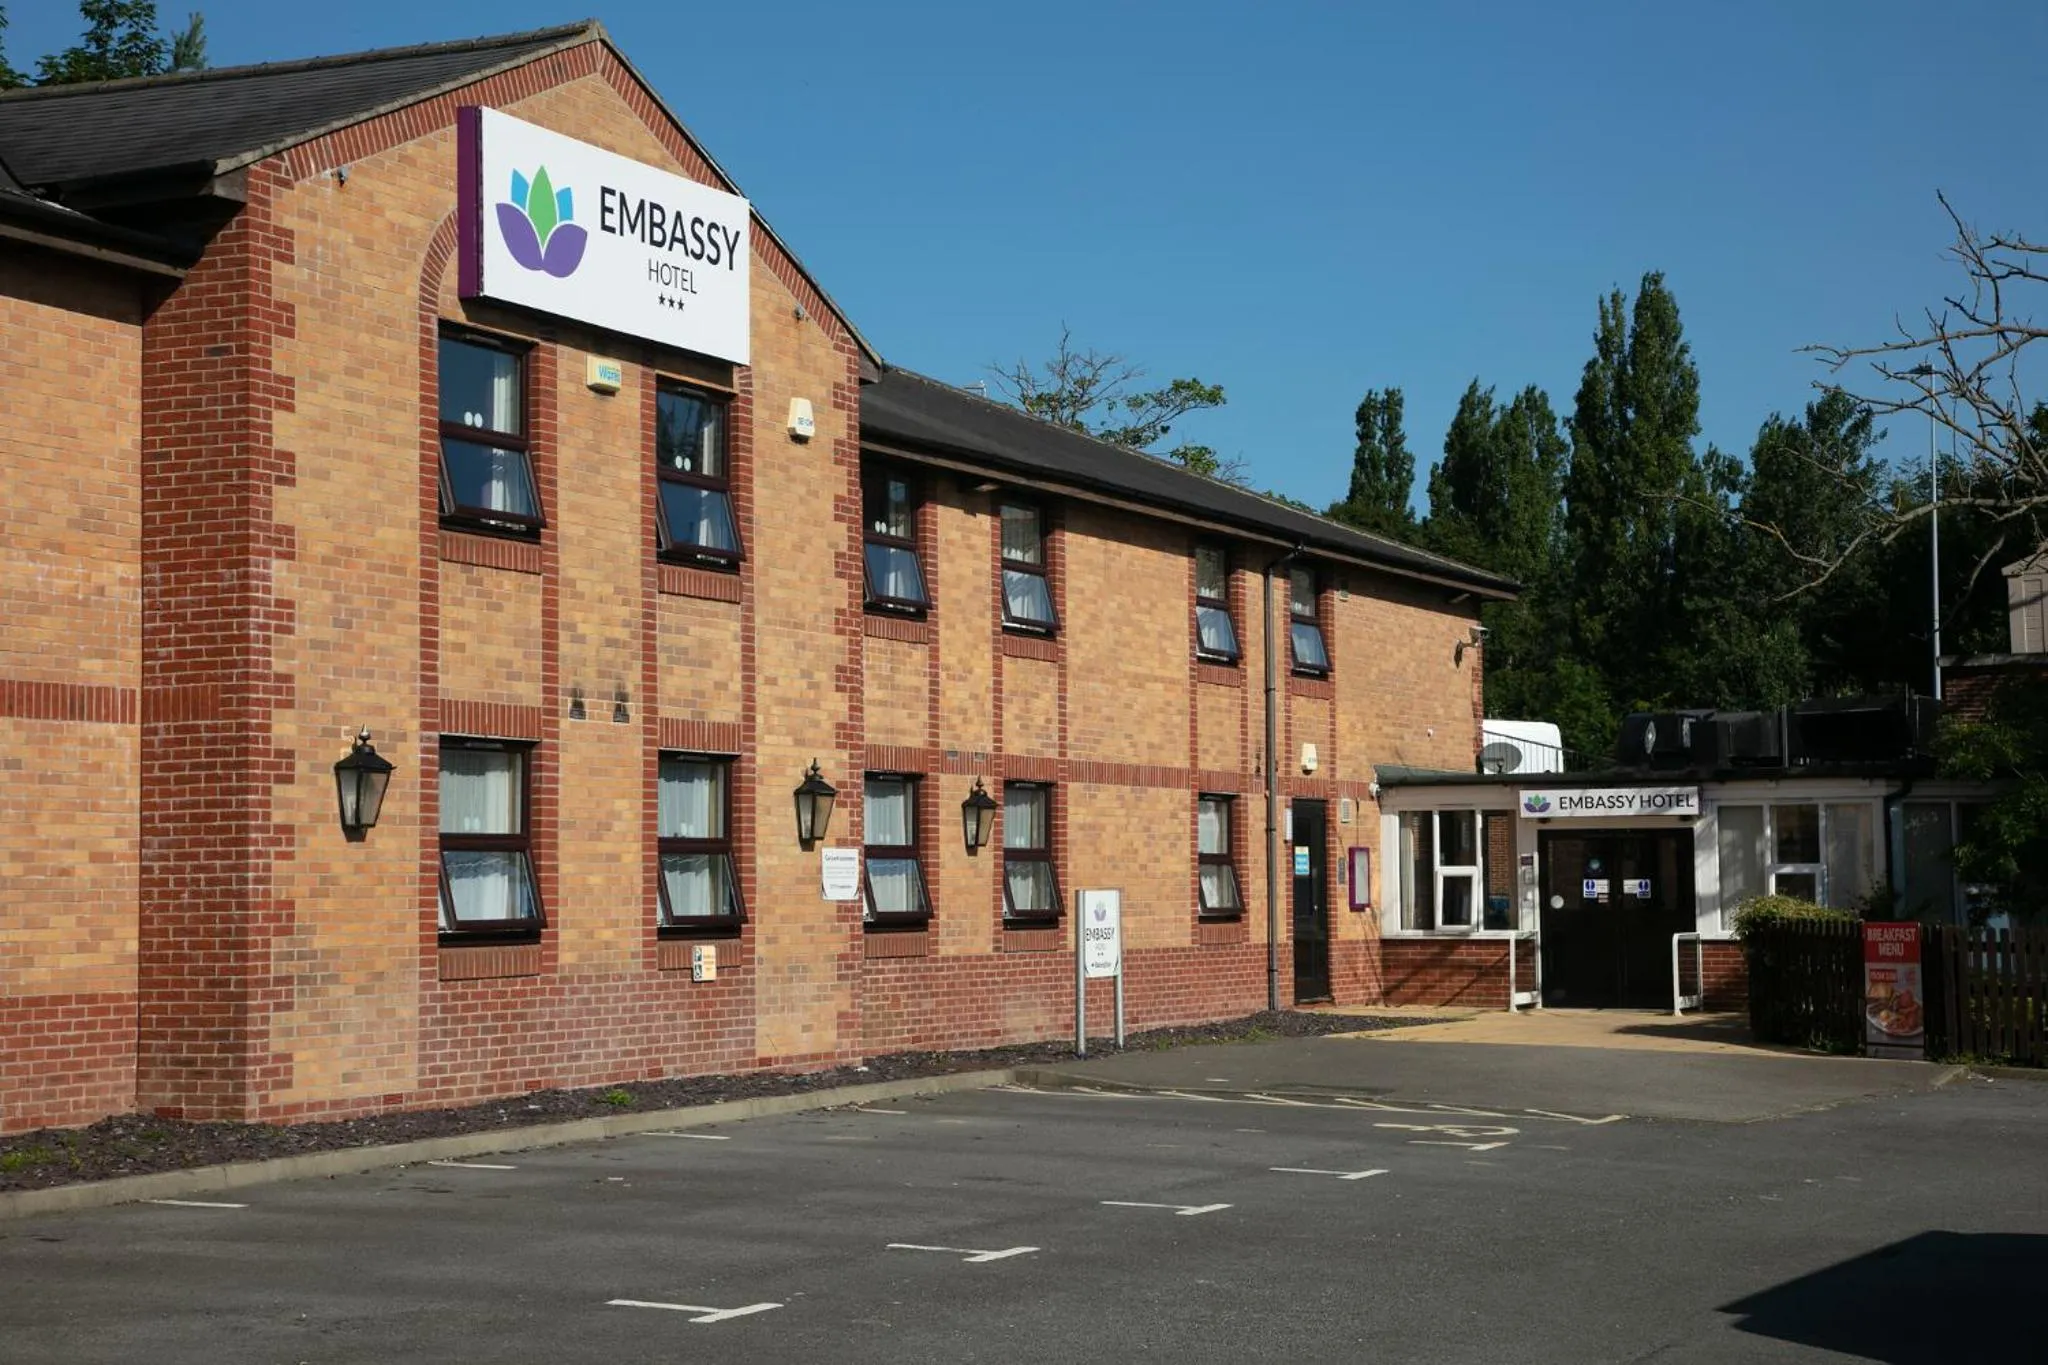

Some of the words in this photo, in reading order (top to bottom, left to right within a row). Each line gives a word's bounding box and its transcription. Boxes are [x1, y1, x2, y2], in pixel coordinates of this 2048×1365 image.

[600, 185, 741, 271] EMBASSY
[648, 259, 697, 295] HOTEL
[1559, 795, 1635, 811] EMBASSY
[1640, 793, 1694, 808] HOTEL
[1085, 927, 1115, 942] EMBASSY
[1867, 927, 1916, 942] BREAKFAST
[1878, 942, 1904, 956] MENU
